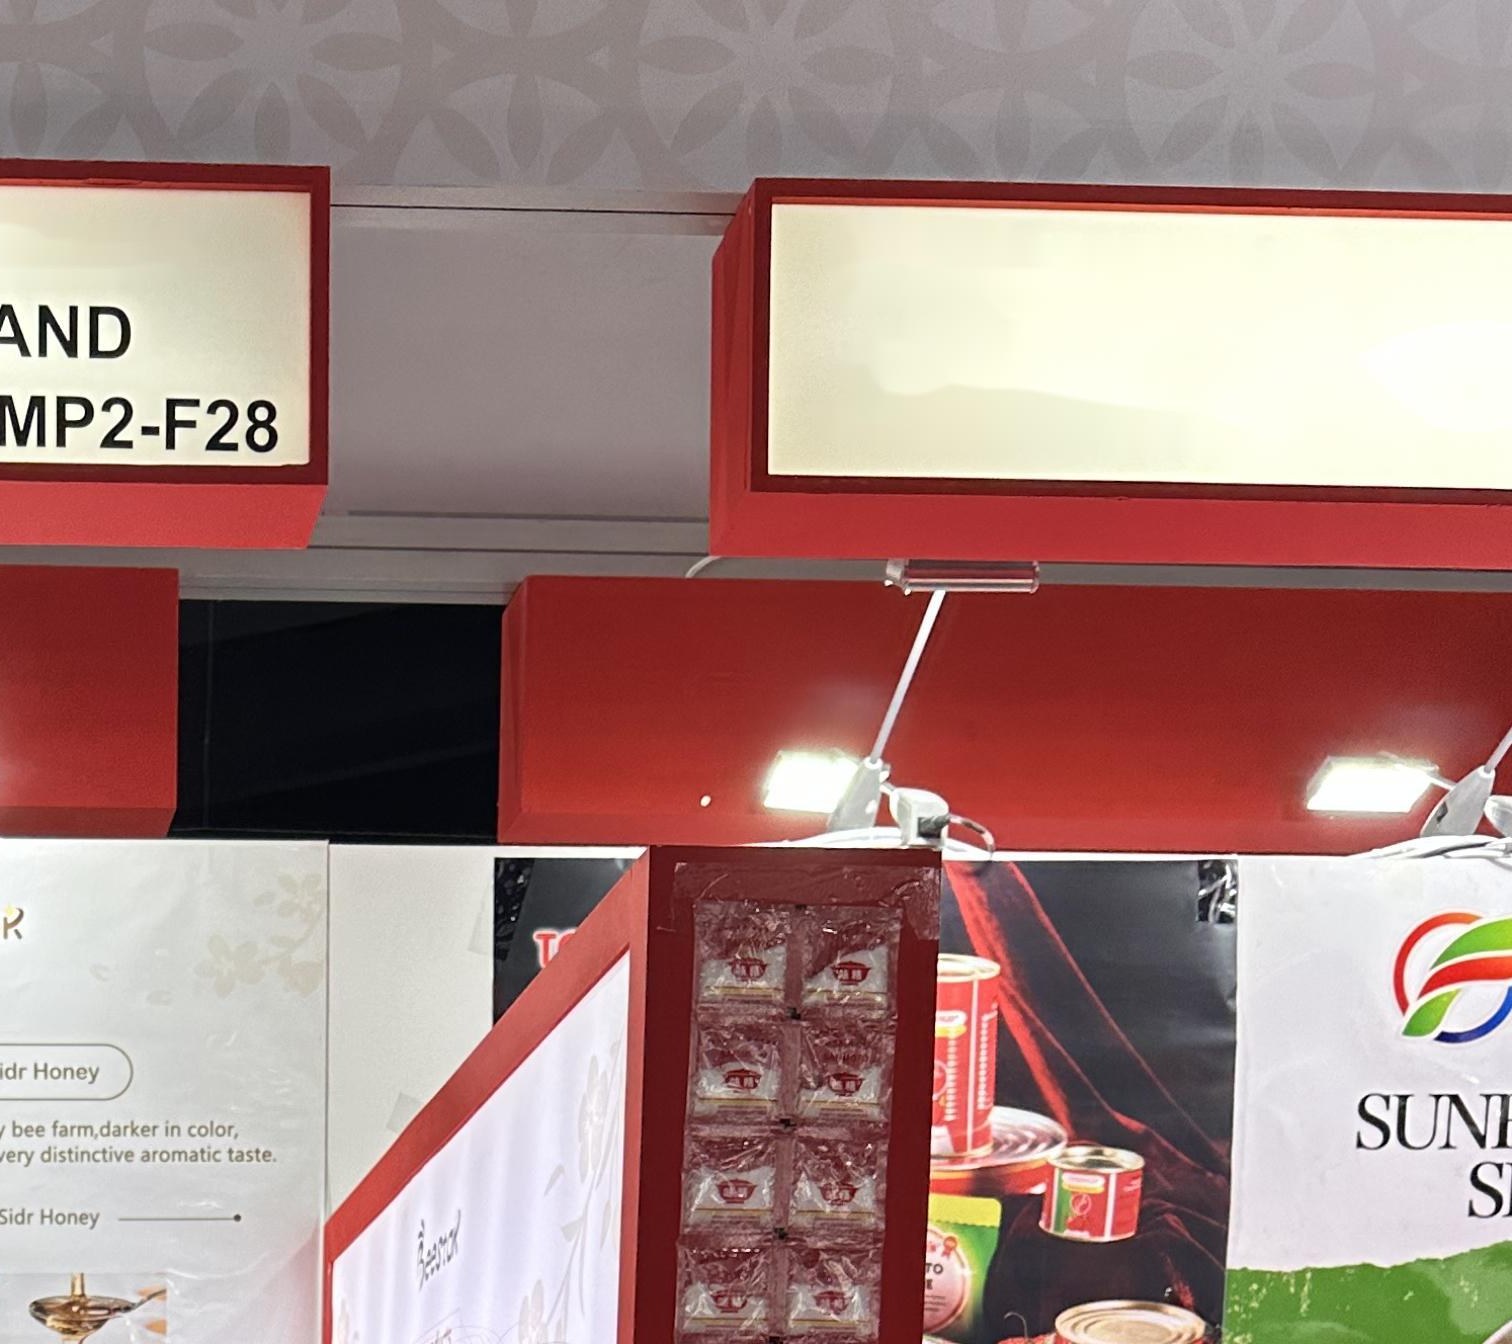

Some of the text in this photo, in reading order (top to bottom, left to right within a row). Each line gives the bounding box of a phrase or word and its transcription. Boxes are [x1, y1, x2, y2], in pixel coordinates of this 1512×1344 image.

[33, 1061, 100, 1085] Honey
[11, 1119, 46, 1139] bee
[164, 1119, 182, 1138] in
[187, 1121, 240, 1142] color,
[39, 1145, 136, 1164] distinctive
[139, 1144, 222, 1164] aromatic
[226, 1146, 277, 1163] taste.
[1467, 1160, 1512, 1219] S
[39, 1208, 101, 1231] Honey
